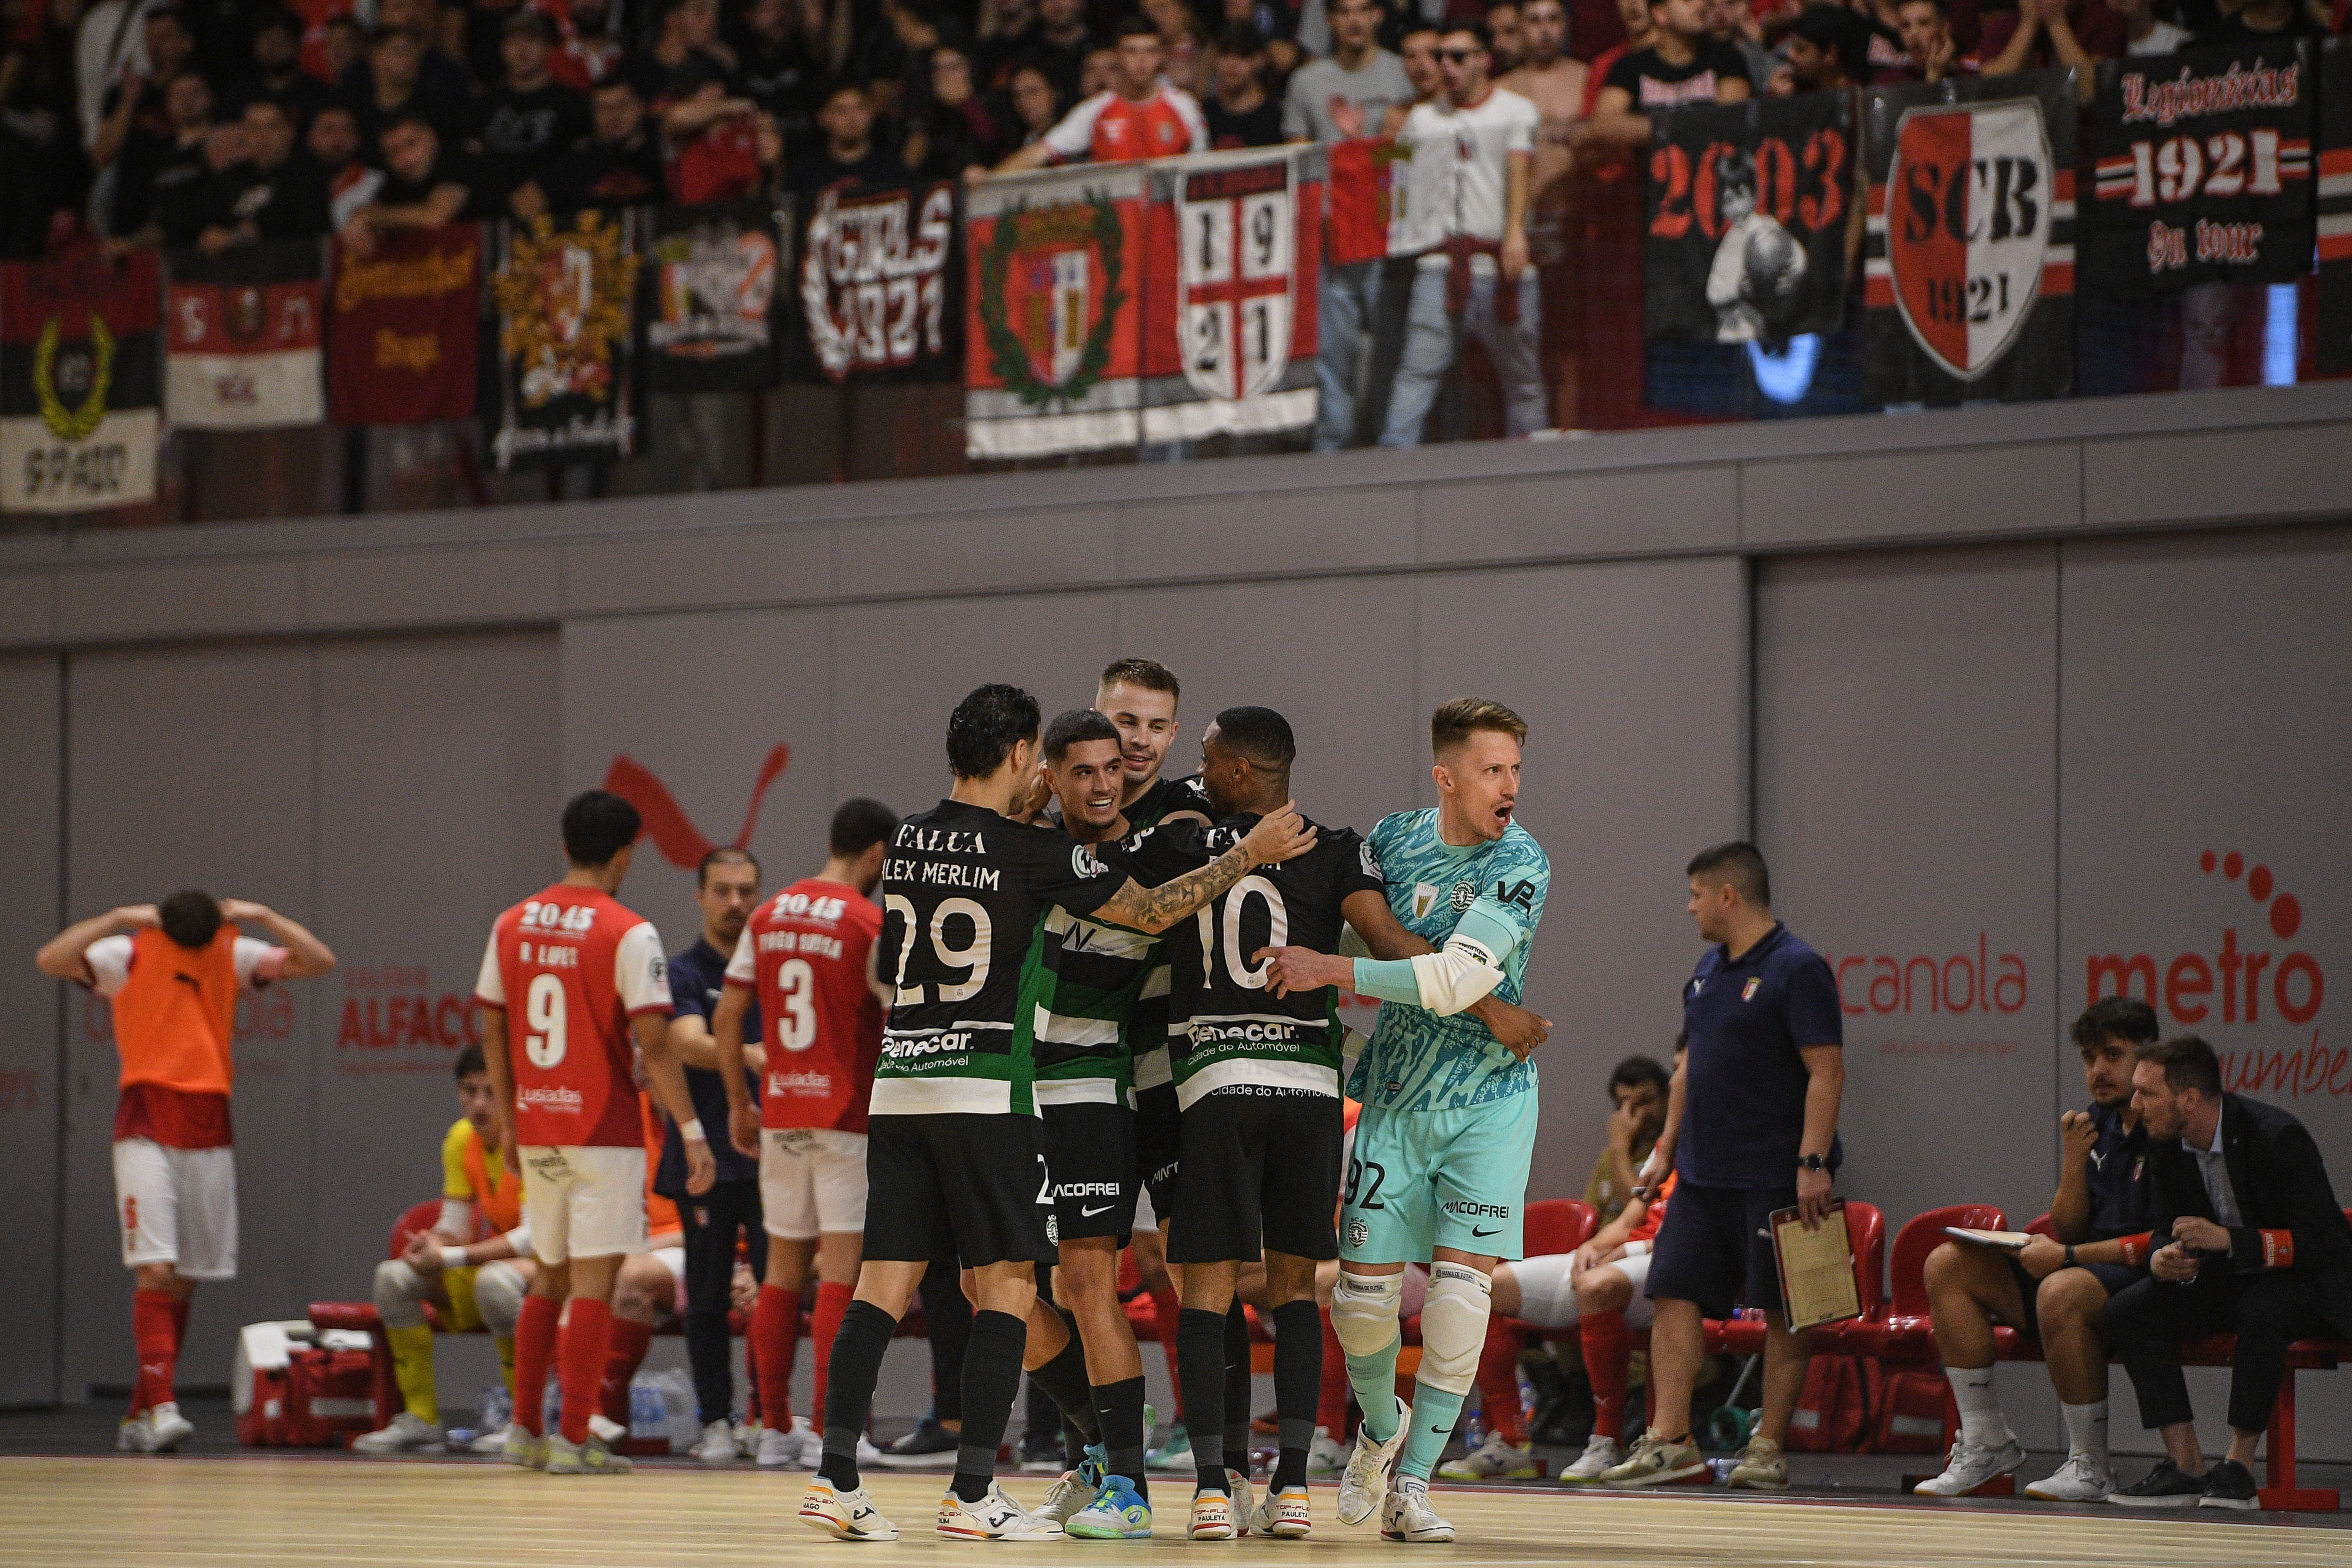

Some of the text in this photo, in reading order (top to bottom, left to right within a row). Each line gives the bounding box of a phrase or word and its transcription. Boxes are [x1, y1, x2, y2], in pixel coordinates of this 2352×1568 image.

[1650, 128, 1846, 240] 2003
[1905, 155, 2039, 245] SCB
[2130, 127, 2282, 207] 1921
[1927, 273, 2009, 324] 1921
[773, 893, 848, 921] 2045
[921, 862, 1000, 891] MERLIM
[520, 901, 597, 930] 2045
[884, 894, 992, 1006] 29
[1197, 874, 1288, 989] 10
[778, 958, 817, 1051] 3
[1824, 930, 2028, 1016] canola
[2088, 928, 2325, 1025] metro
[526, 973, 567, 1068] 9
[1188, 1041, 1299, 1066] Cidade do Automóvel
[911, 1055, 969, 1072] Automóvel
[1256, 1086, 1272, 1096] do
[2218, 1026, 2352, 1100] umbe
[1344, 1157, 1385, 1209] 92
[1442, 1201, 1509, 1219] MACOFREI
